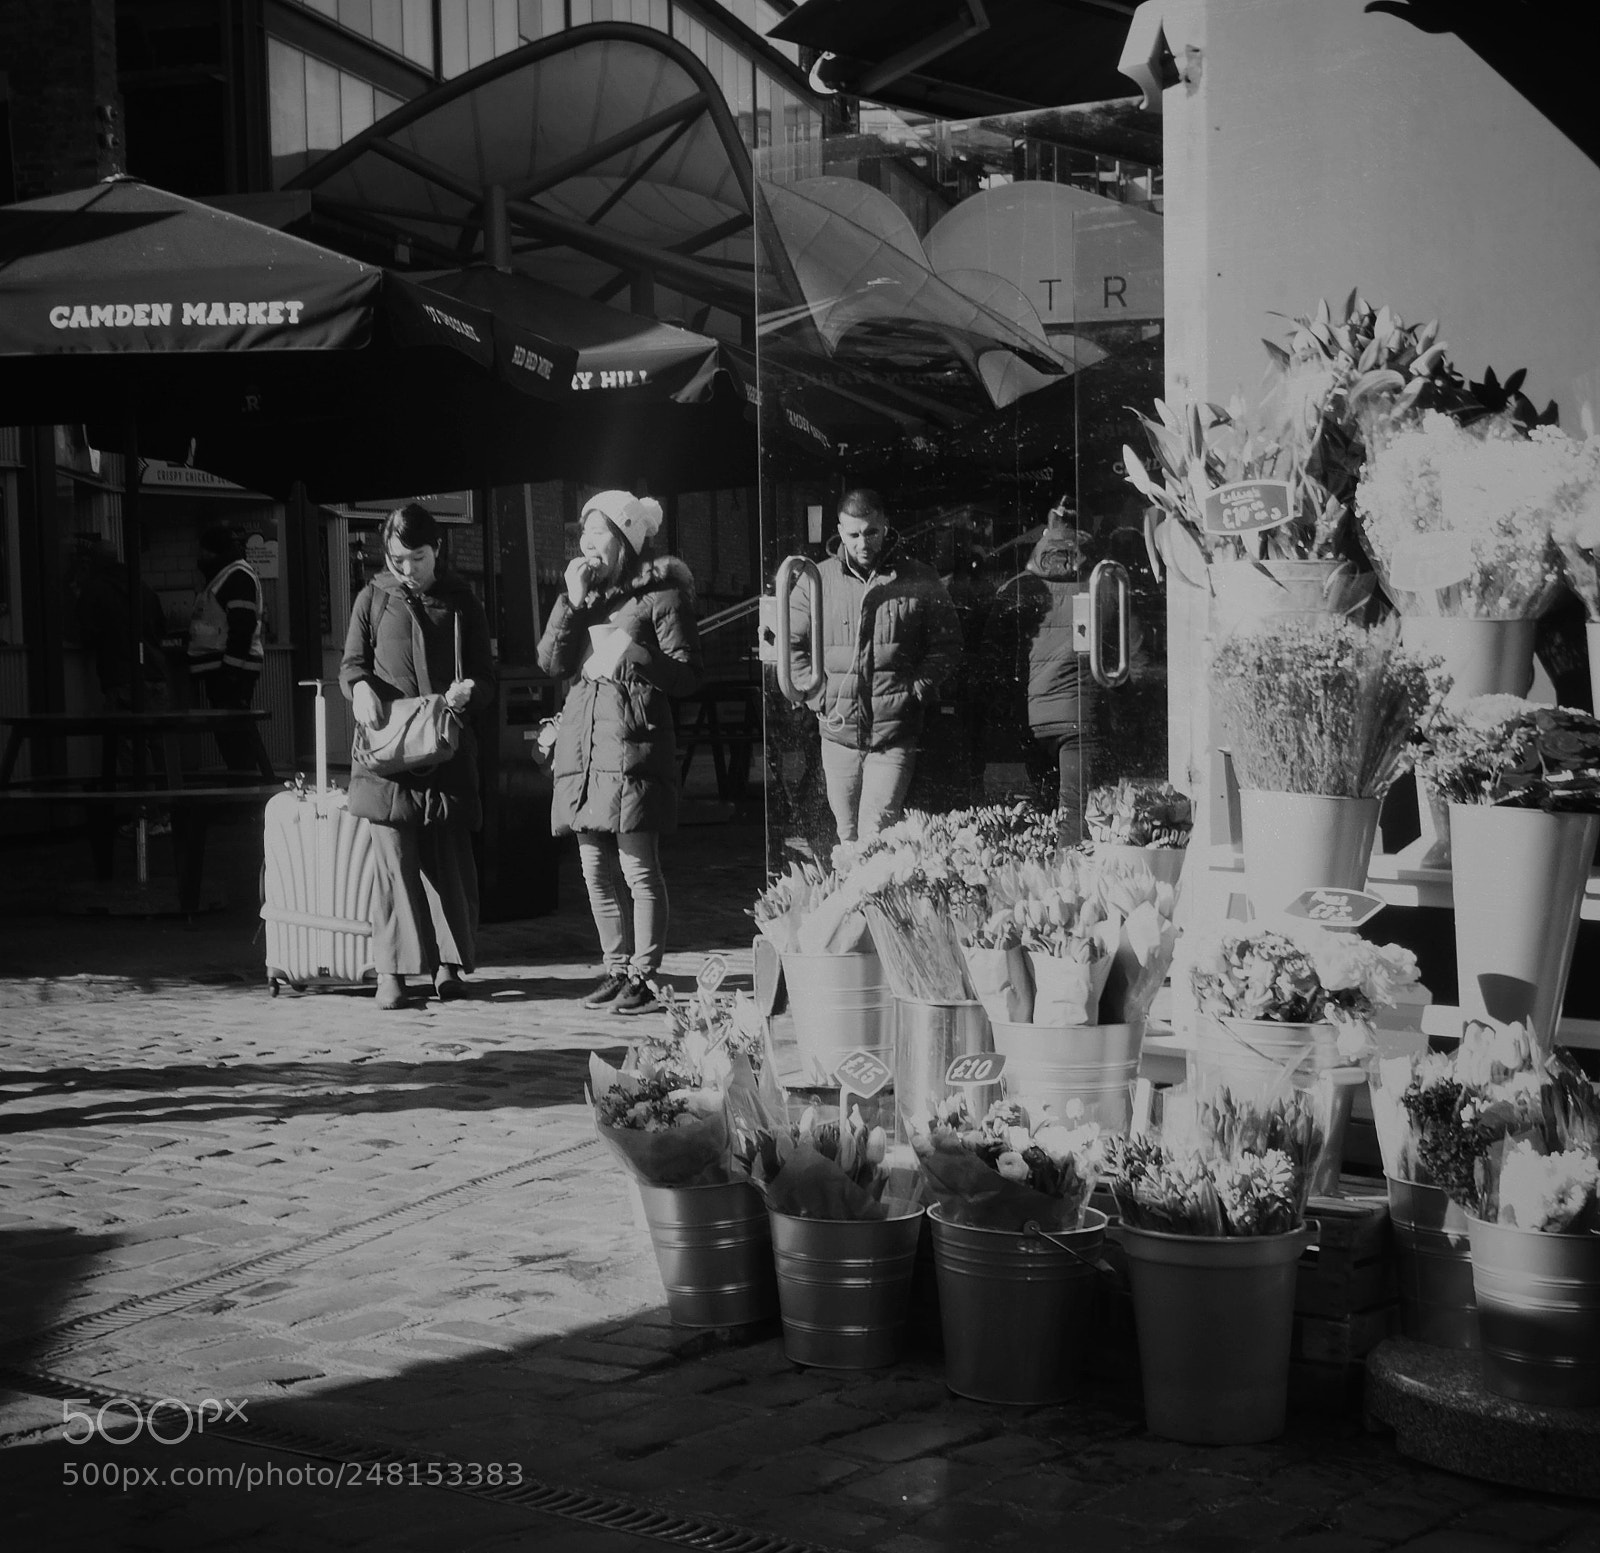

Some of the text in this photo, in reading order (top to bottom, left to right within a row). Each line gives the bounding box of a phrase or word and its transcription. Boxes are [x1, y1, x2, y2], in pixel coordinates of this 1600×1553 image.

[49, 300, 305, 329] CAMDEN MARKET
[157, 470, 183, 482] CRISPY
[840, 1056, 885, 1085] £15
[950, 1058, 993, 1080] £10
